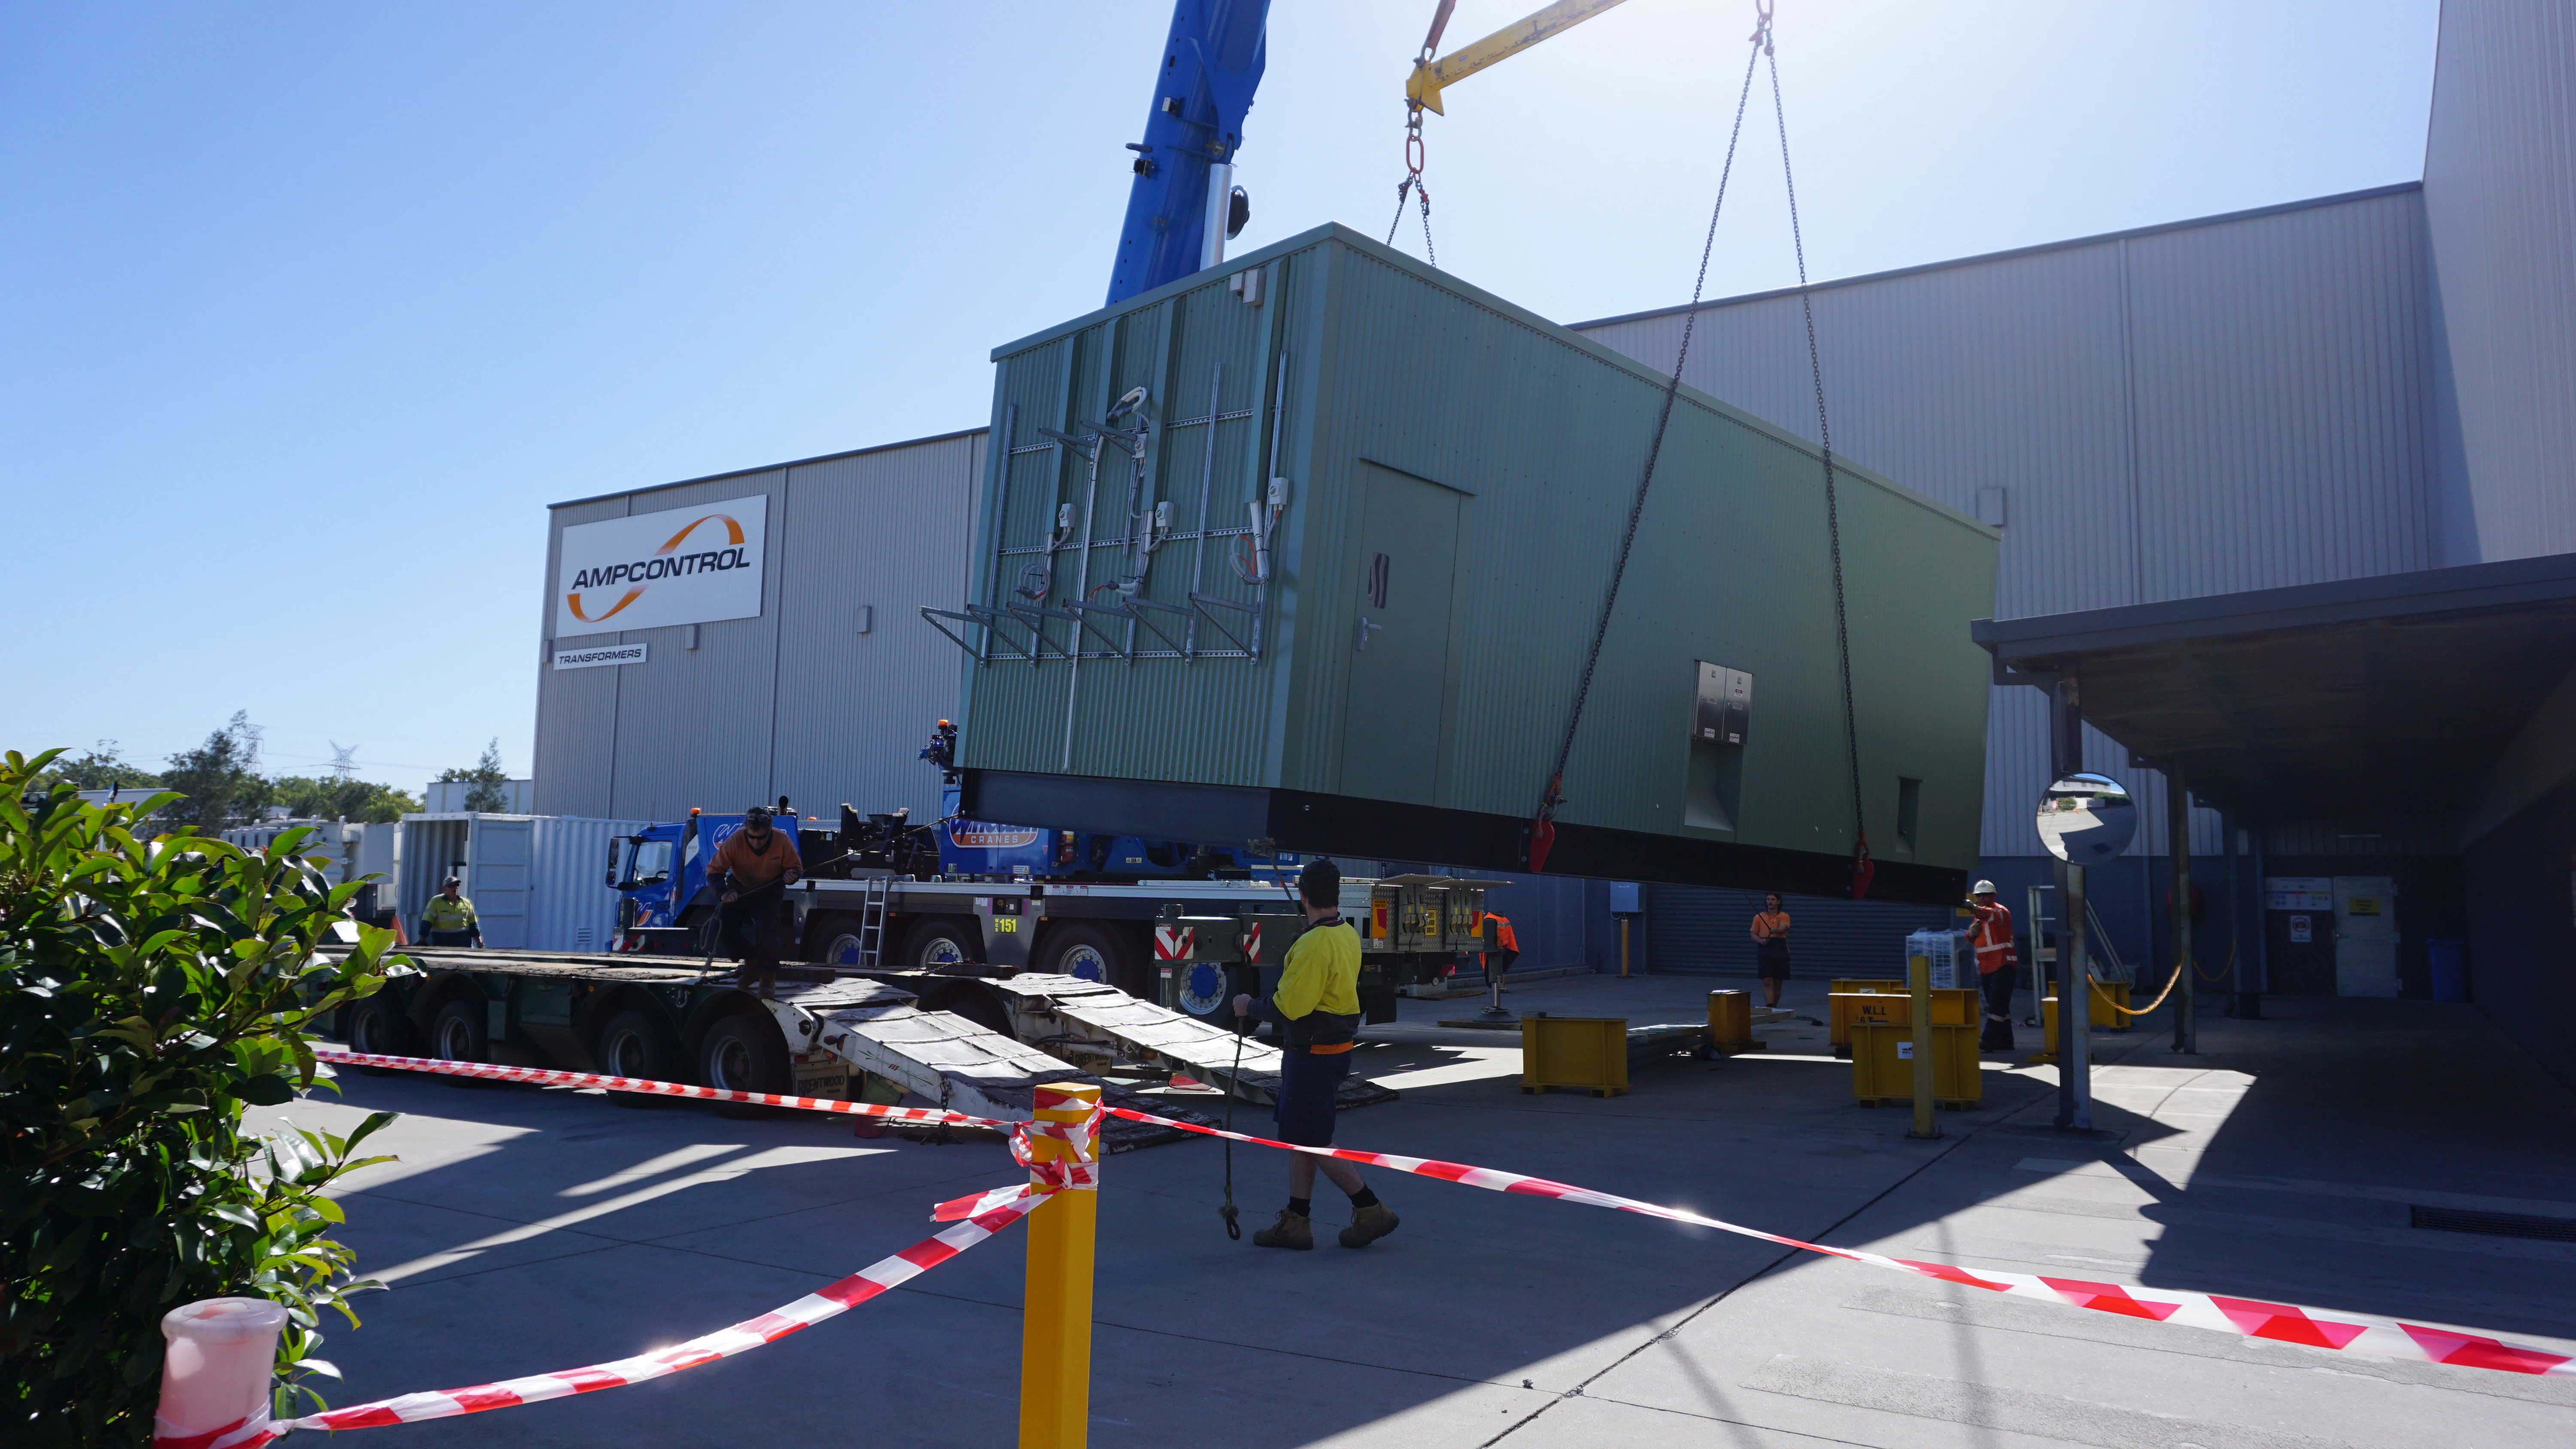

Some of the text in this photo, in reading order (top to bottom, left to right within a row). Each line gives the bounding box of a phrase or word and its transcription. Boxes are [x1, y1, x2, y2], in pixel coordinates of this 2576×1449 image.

[571, 547, 750, 590] AMPCONTROL
[559, 649, 641, 665] TRANSFORMERS
[971, 835, 1018, 843] CRANES
[1000, 919, 1016, 932] 151
